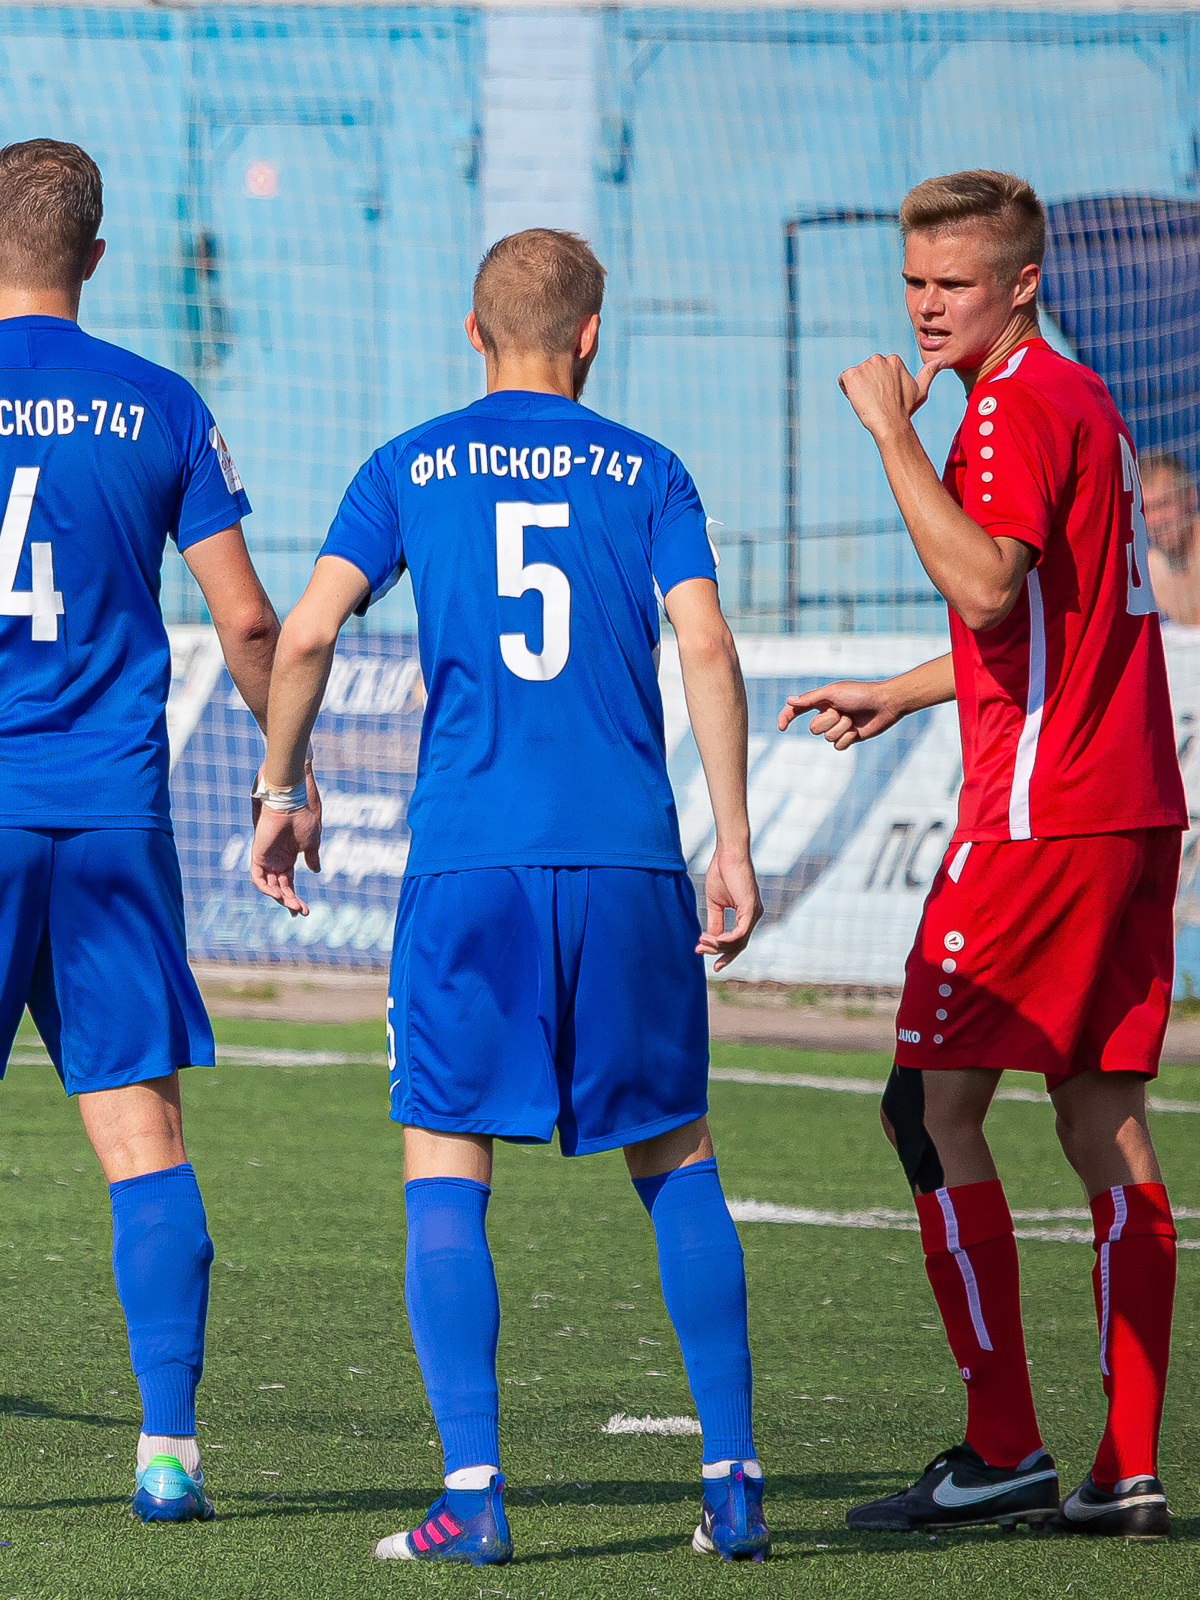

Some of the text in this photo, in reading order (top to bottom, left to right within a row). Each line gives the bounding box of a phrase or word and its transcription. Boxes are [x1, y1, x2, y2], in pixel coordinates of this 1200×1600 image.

[410, 442, 643, 487] ФК ПСКОВ-747
[495, 501, 571, 682] 5
